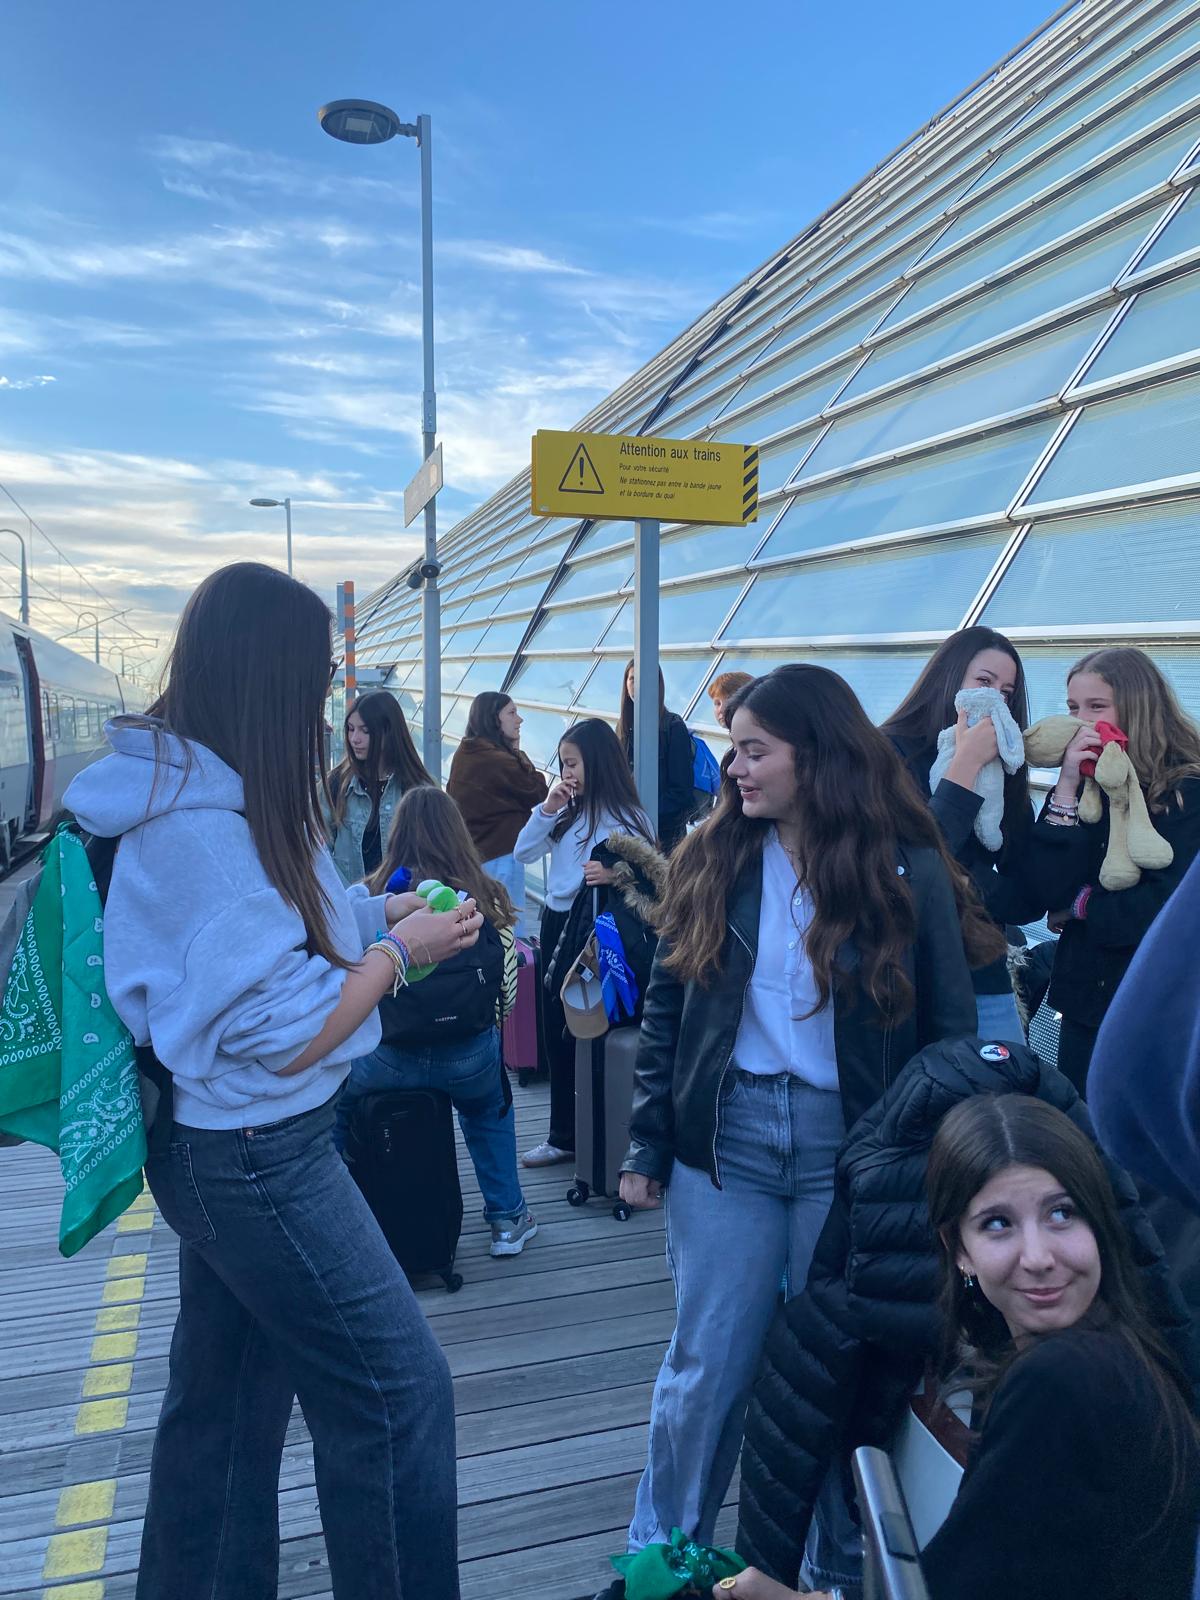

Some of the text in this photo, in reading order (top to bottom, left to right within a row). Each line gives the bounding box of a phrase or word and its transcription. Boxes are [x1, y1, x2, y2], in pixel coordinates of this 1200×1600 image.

[620, 442, 721, 461] Attention aux trains
[649, 465, 669, 473] sécurité
[620, 476, 627, 484] Ne
[629, 478, 656, 486] stationnez
[657, 480, 667, 488] pas
[690, 481, 706, 489] bande
[633, 490, 653, 498] bordure
